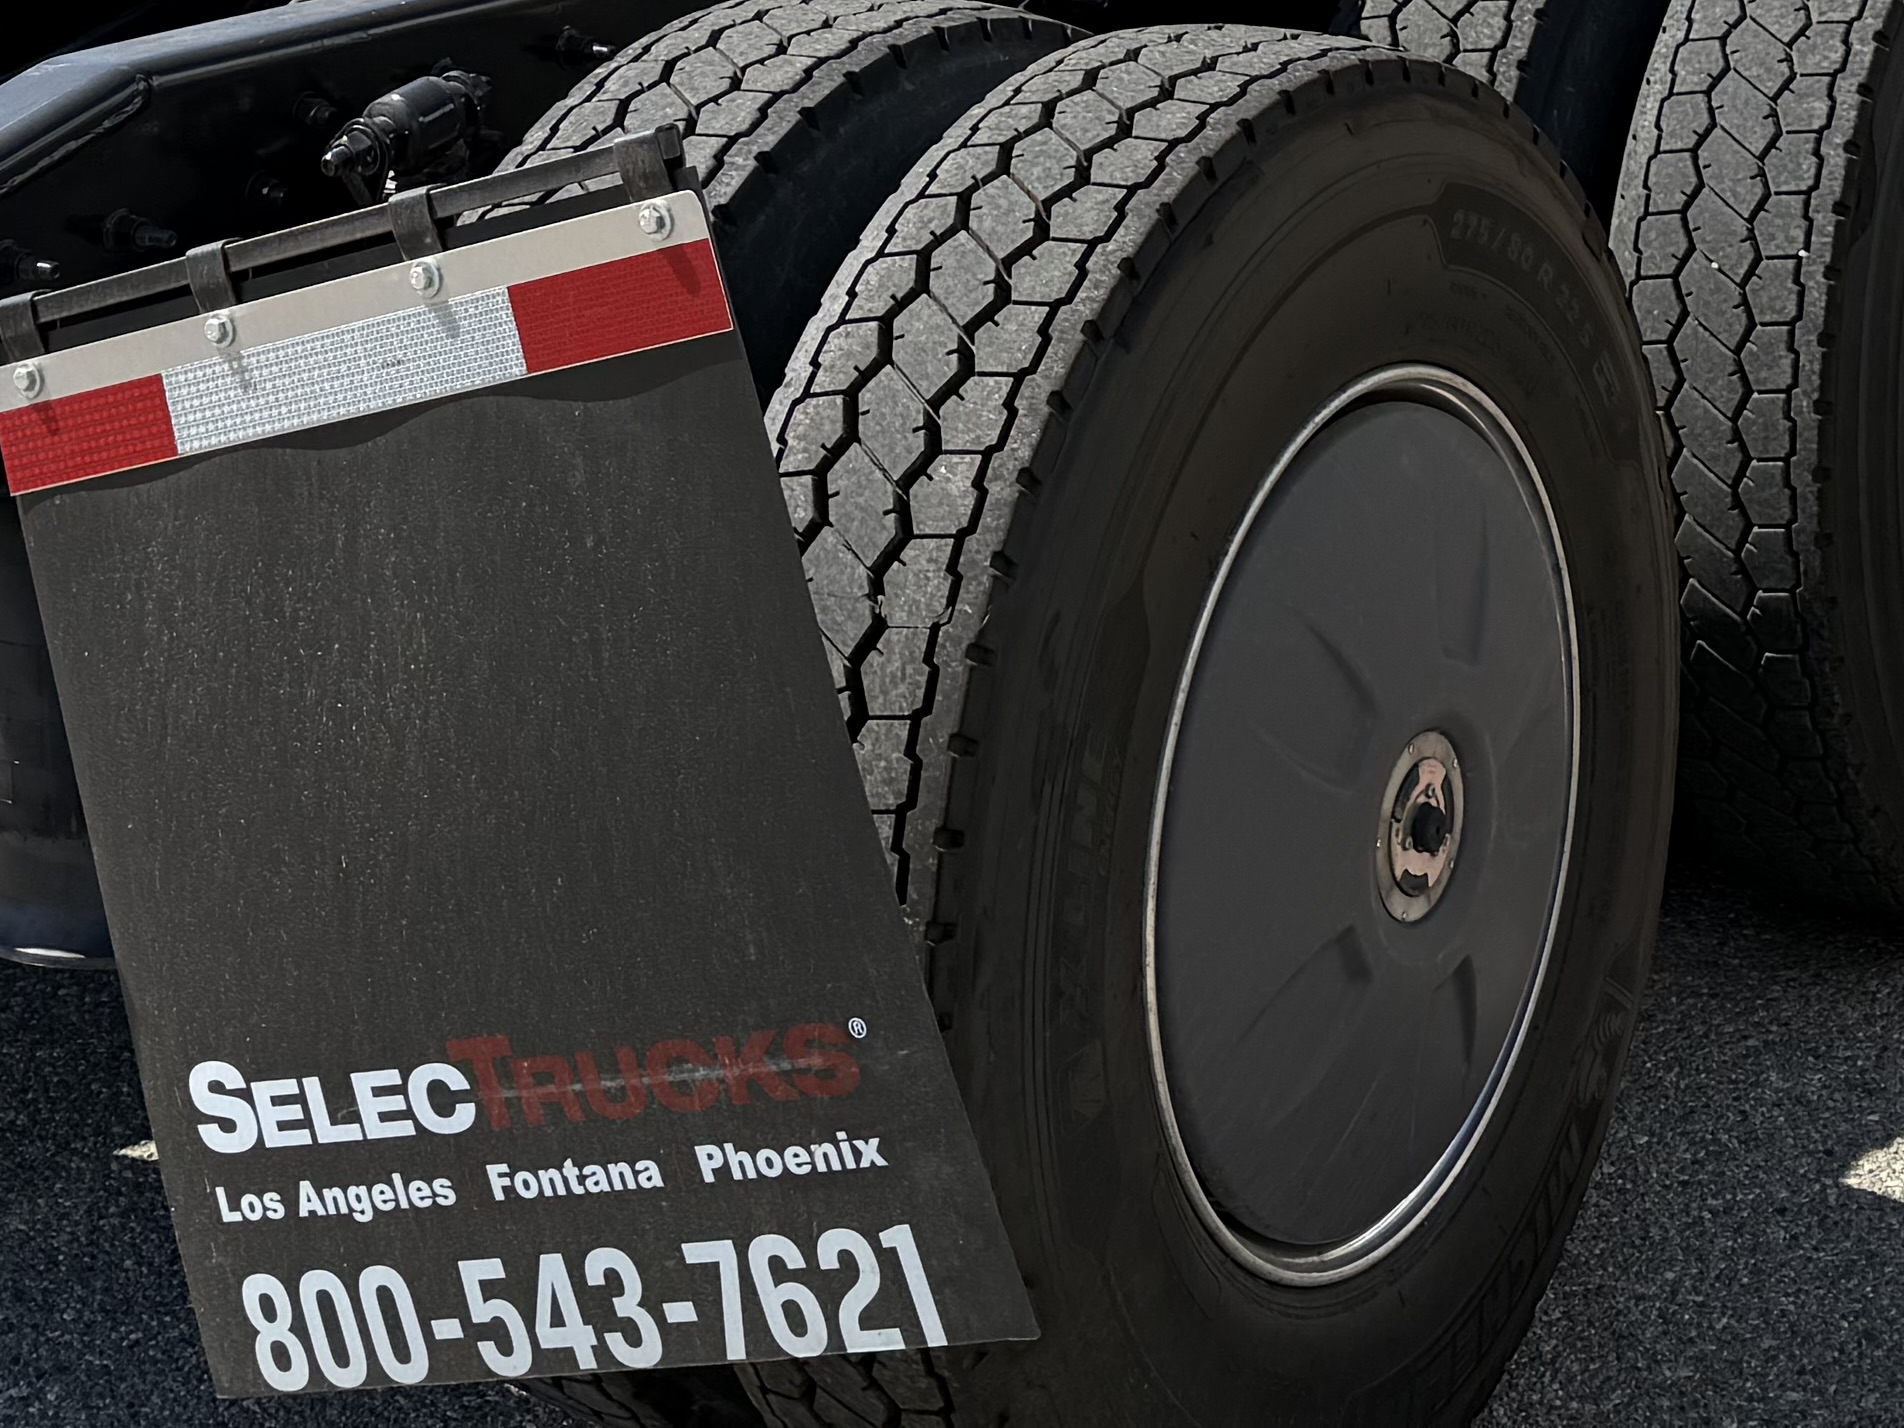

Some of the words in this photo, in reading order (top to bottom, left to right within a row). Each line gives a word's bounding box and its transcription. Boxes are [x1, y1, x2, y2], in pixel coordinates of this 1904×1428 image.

[214, 1185, 286, 1223] Los
[297, 1172, 457, 1223] Angeles
[485, 1155, 665, 1202] Fontana
[694, 1130, 889, 1184] Phoenix
[240, 1223, 949, 1392] 800-543-7621
